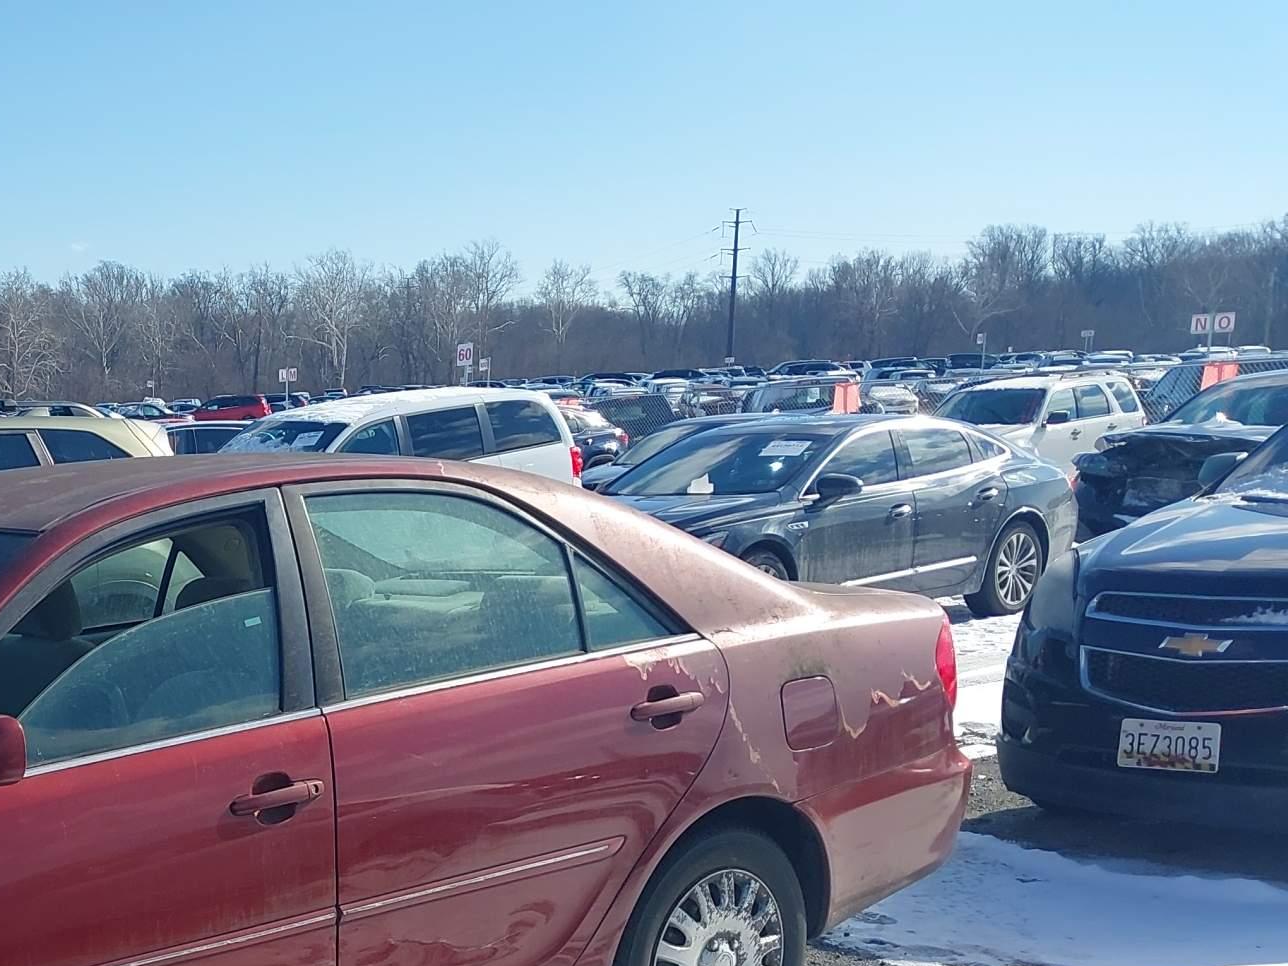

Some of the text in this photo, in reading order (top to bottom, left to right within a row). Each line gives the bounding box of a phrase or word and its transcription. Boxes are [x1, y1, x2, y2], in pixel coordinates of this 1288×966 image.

[1194, 317, 1207, 331] N
[458, 347, 472, 361] 60
[1123, 732, 1213, 761] 3EZ3085
